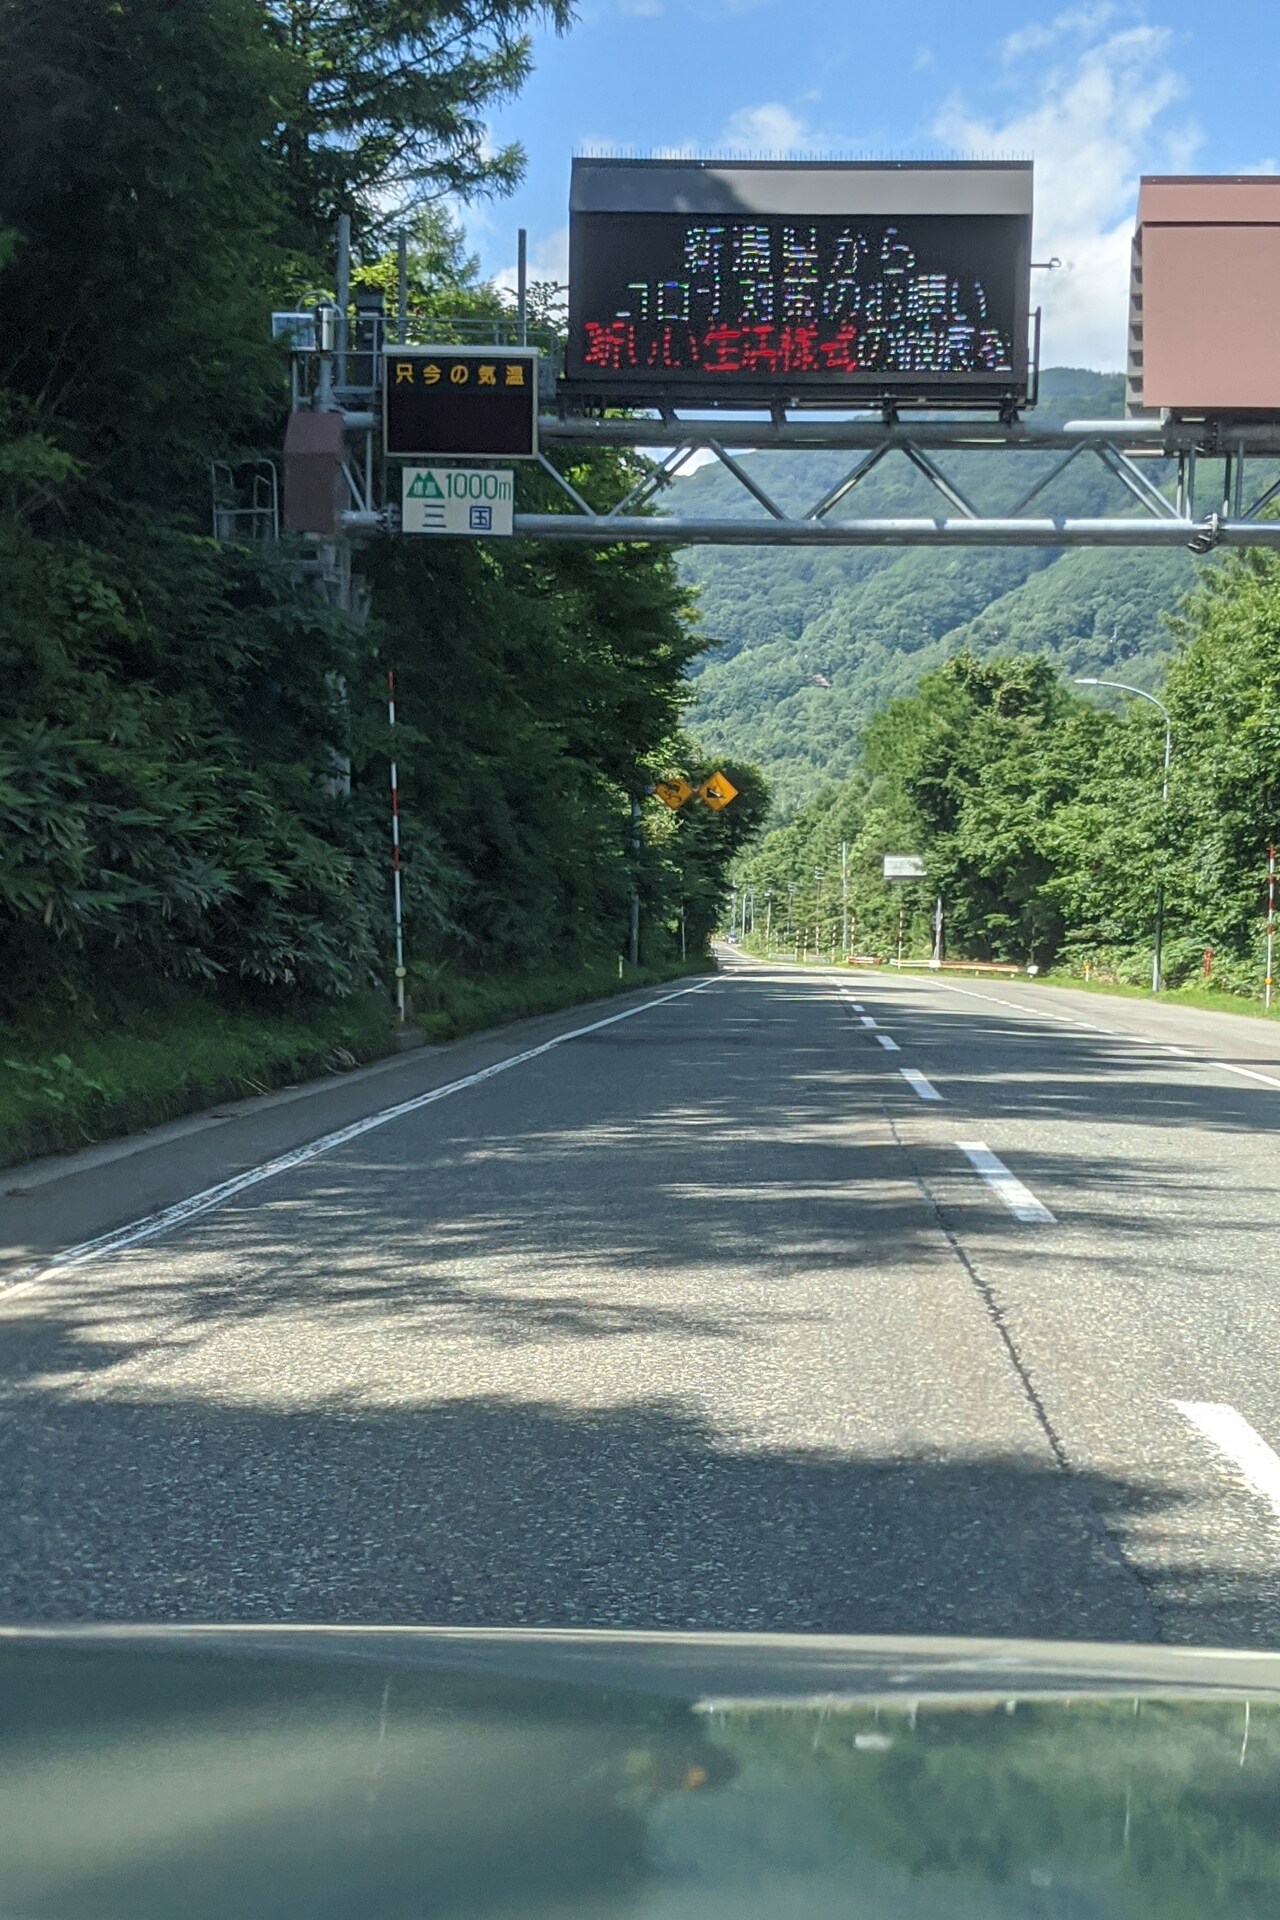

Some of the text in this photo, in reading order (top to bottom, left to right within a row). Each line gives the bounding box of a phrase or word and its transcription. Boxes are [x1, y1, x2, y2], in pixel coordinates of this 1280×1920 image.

[396, 364, 525, 386] 只今の気温
[445, 473, 511, 500] 1000m
[422, 503, 493, 530] 三国
